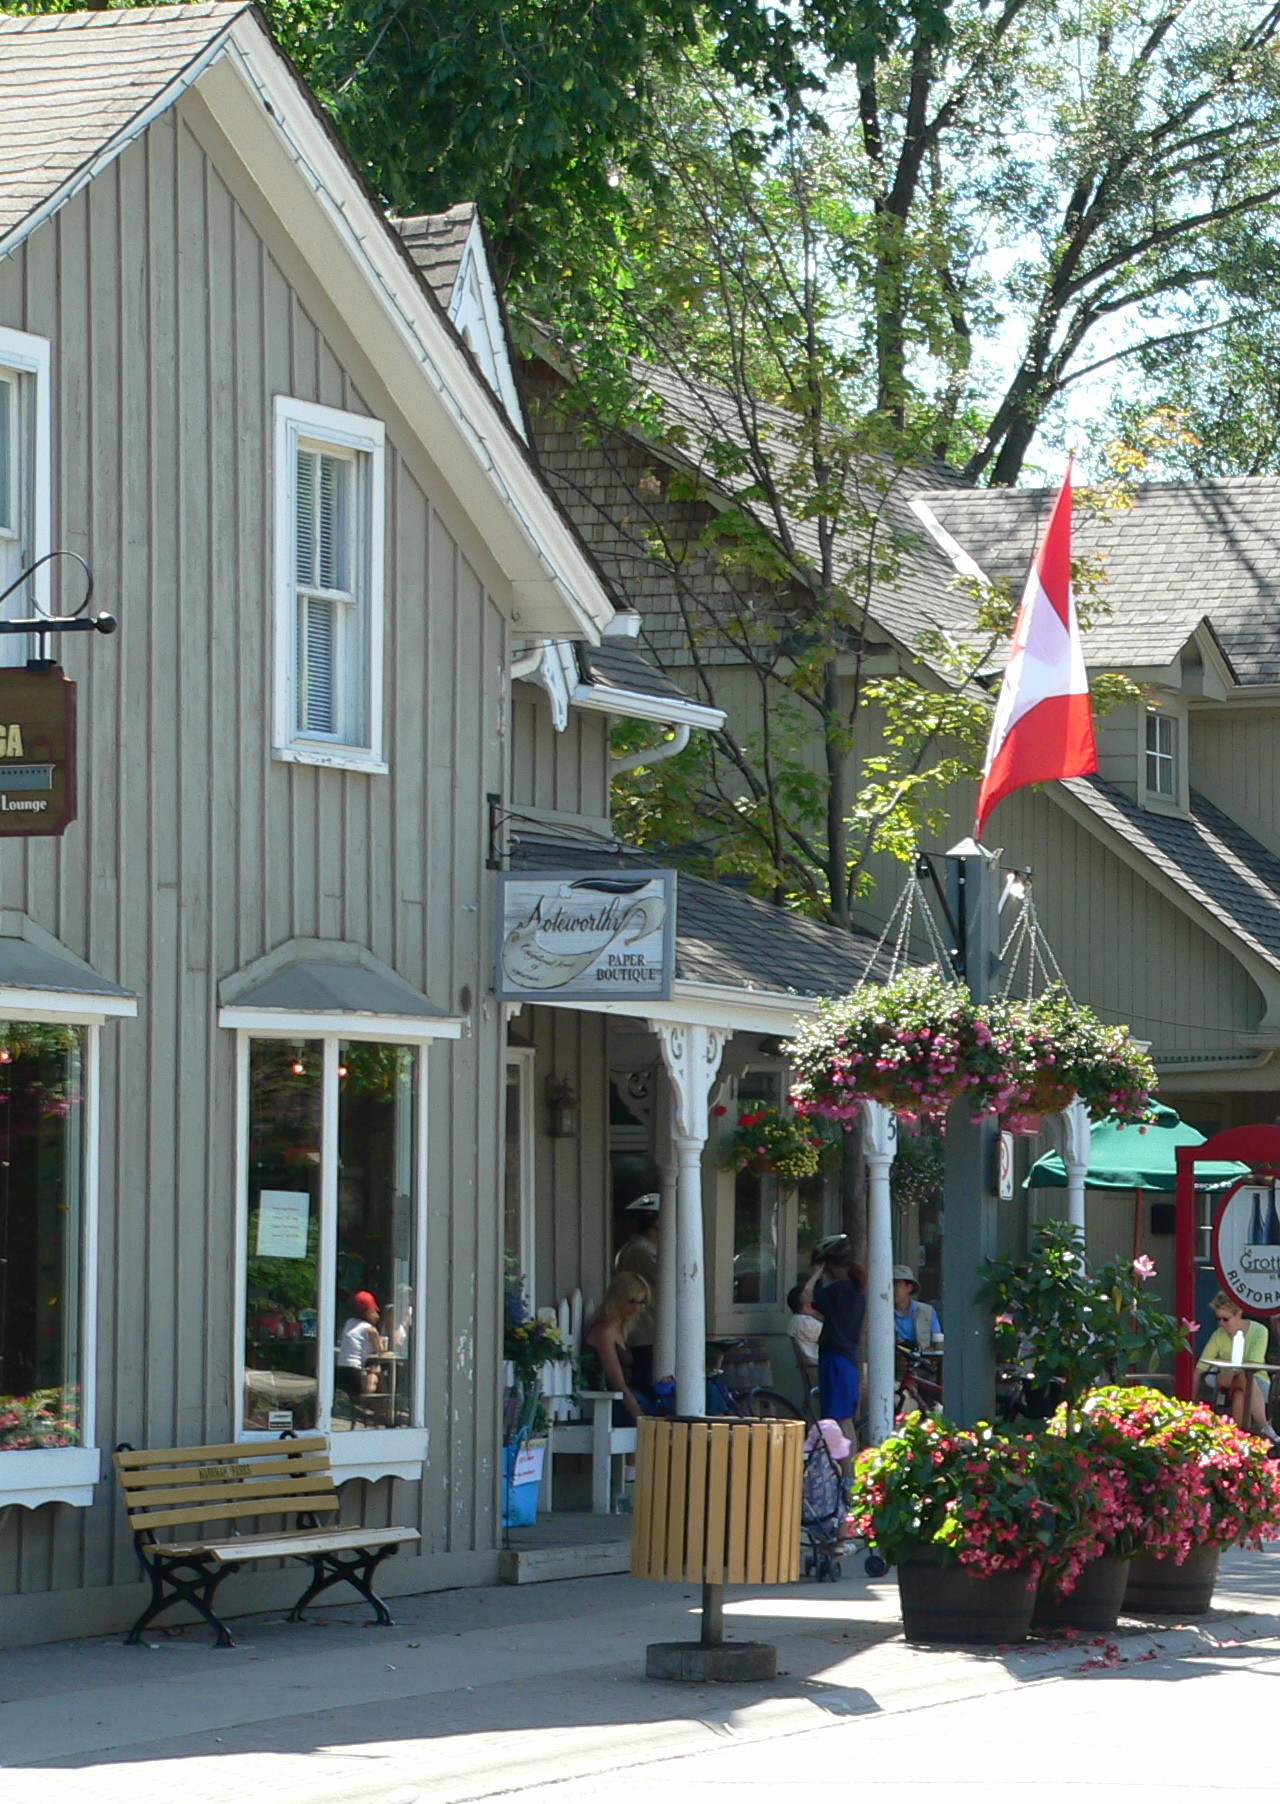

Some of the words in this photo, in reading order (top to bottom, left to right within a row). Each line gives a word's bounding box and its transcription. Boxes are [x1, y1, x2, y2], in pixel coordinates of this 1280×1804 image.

[1, 794, 48, 813] Lounge
[608, 954, 646, 966] PAPER
[596, 969, 656, 982] BOUTIQUE
